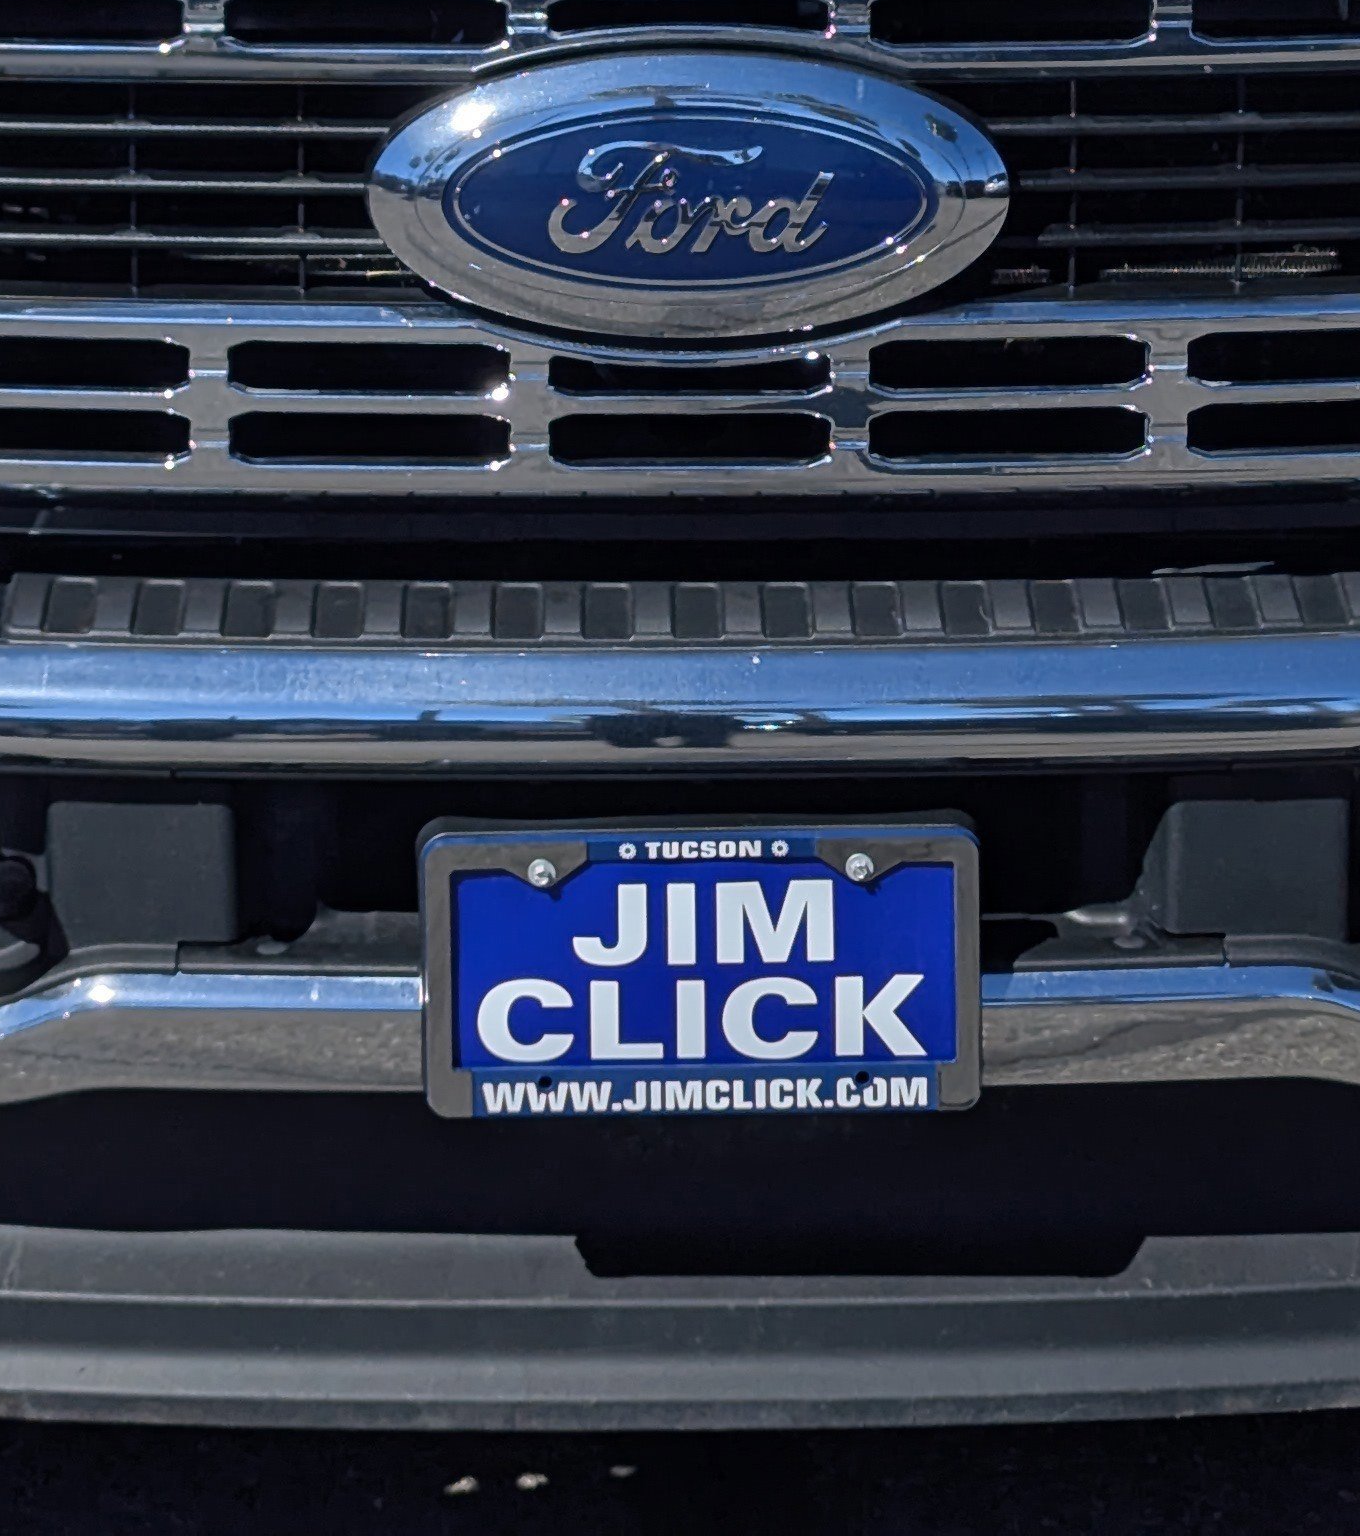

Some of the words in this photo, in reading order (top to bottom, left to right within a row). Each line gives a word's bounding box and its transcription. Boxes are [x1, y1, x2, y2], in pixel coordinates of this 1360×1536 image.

[547, 139, 836, 255] Ford
[645, 840, 762, 860] TUCSON
[572, 878, 835, 966] JIM
[476, 974, 928, 1063] CLICK
[482, 1076, 929, 1115] WWW.JIMCLICK.COM
